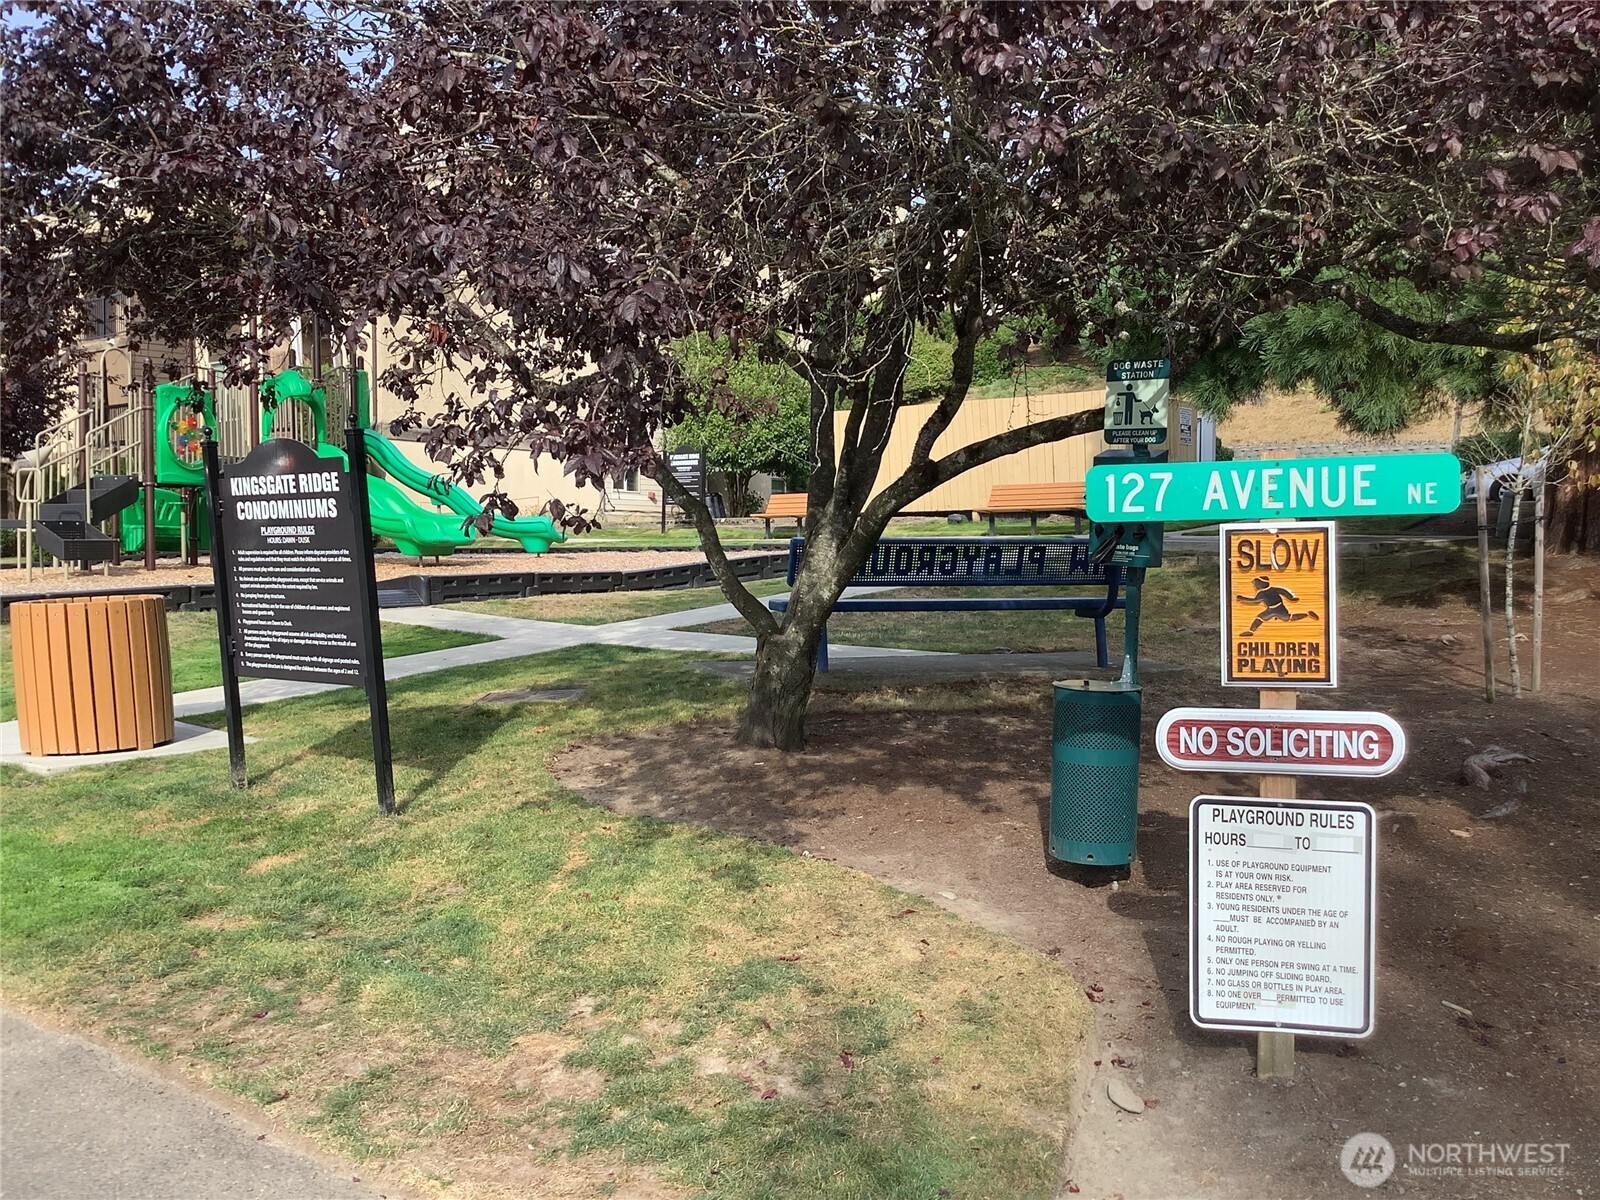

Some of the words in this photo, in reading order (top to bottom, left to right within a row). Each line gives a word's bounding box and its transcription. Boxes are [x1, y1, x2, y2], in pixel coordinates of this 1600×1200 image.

[1114, 362, 1130, 370] DOG
[1134, 360, 1163, 368] WASTE
[1122, 371, 1154, 379] STATION
[230, 474, 296, 496] KINGSGATE
[299, 472, 339, 493] RIDGE
[1105, 472, 1173, 513] 127
[1202, 464, 1377, 511] AVENUE
[1408, 482, 1437, 505] NE
[236, 498, 337, 520] CONDOMINIUMS
[1237, 538, 1320, 572] SLOW
[1237, 642, 1320, 657] CHILDREN
[1237, 658, 1320, 674] PLAYING
[1179, 726, 1218, 755] NO
[1226, 727, 1379, 760] SOLICITING
[1213, 808, 1304, 826] PLAYGROUND
[1310, 813, 1354, 829] RULES
[1205, 832, 1246, 846] HOURS
[1295, 837, 1310, 850] TO
[1243, 861, 1289, 870] PLAYGROUND
[1291, 864, 1331, 873] EQUIPMENT
[1255, 884, 1290, 892] RESERVED
[1216, 892, 1253, 901] RESIDENTS
[1216, 903, 1240, 911] YOUNG
[1242, 904, 1280, 914] RESIDENTS
[1266, 917, 1316, 927] ACCOMPANIED
[1228, 936, 1252, 944] ROUGH
[1254, 938, 1283, 946] PLAYING
[1298, 941, 1326, 950] YELLING
[1216, 946, 1256, 955] PERMITTED.
[1251, 960, 1278, 968] PERSON
[1296, 963, 1320, 971] SWING
[1339, 966, 1358, 974] TIME.
[1228, 969, 1258, 977] JUMPING
[1276, 972, 1303, 981] SLIDING
[1306, 974, 1332, 983] BOARD.
[1228, 980, 1249, 988] GLASS
[1264, 982, 1294, 991] BOTTLES
[1216, 1001, 1256, 1010] EQUIPMENT.
